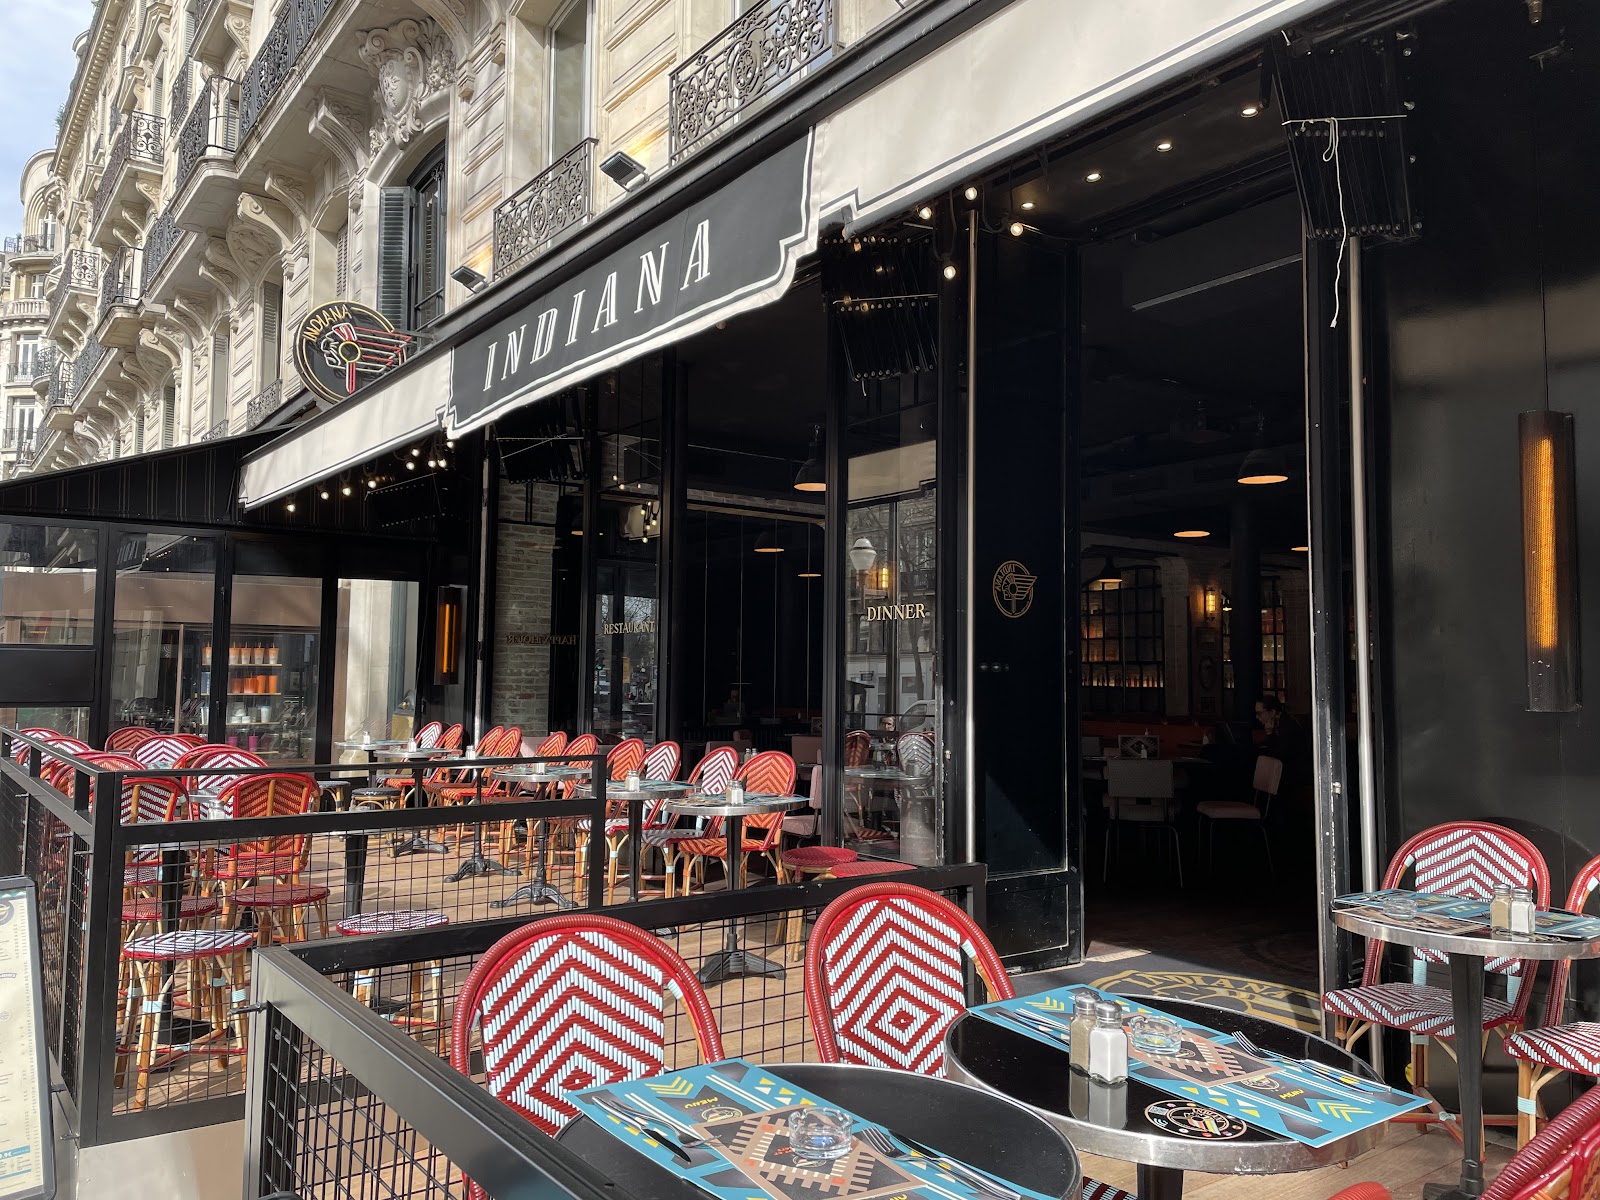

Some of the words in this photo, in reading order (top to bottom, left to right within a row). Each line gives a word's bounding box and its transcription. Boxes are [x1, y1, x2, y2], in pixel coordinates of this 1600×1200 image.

[483, 219, 711, 391] INDIANA
[302, 304, 352, 342] INDIANA
[867, 603, 926, 621] DINNER
[603, 621, 656, 635] RESTAURANT
[1121, 973, 1293, 999] INDIANA
[684, 1096, 718, 1109] MENU
